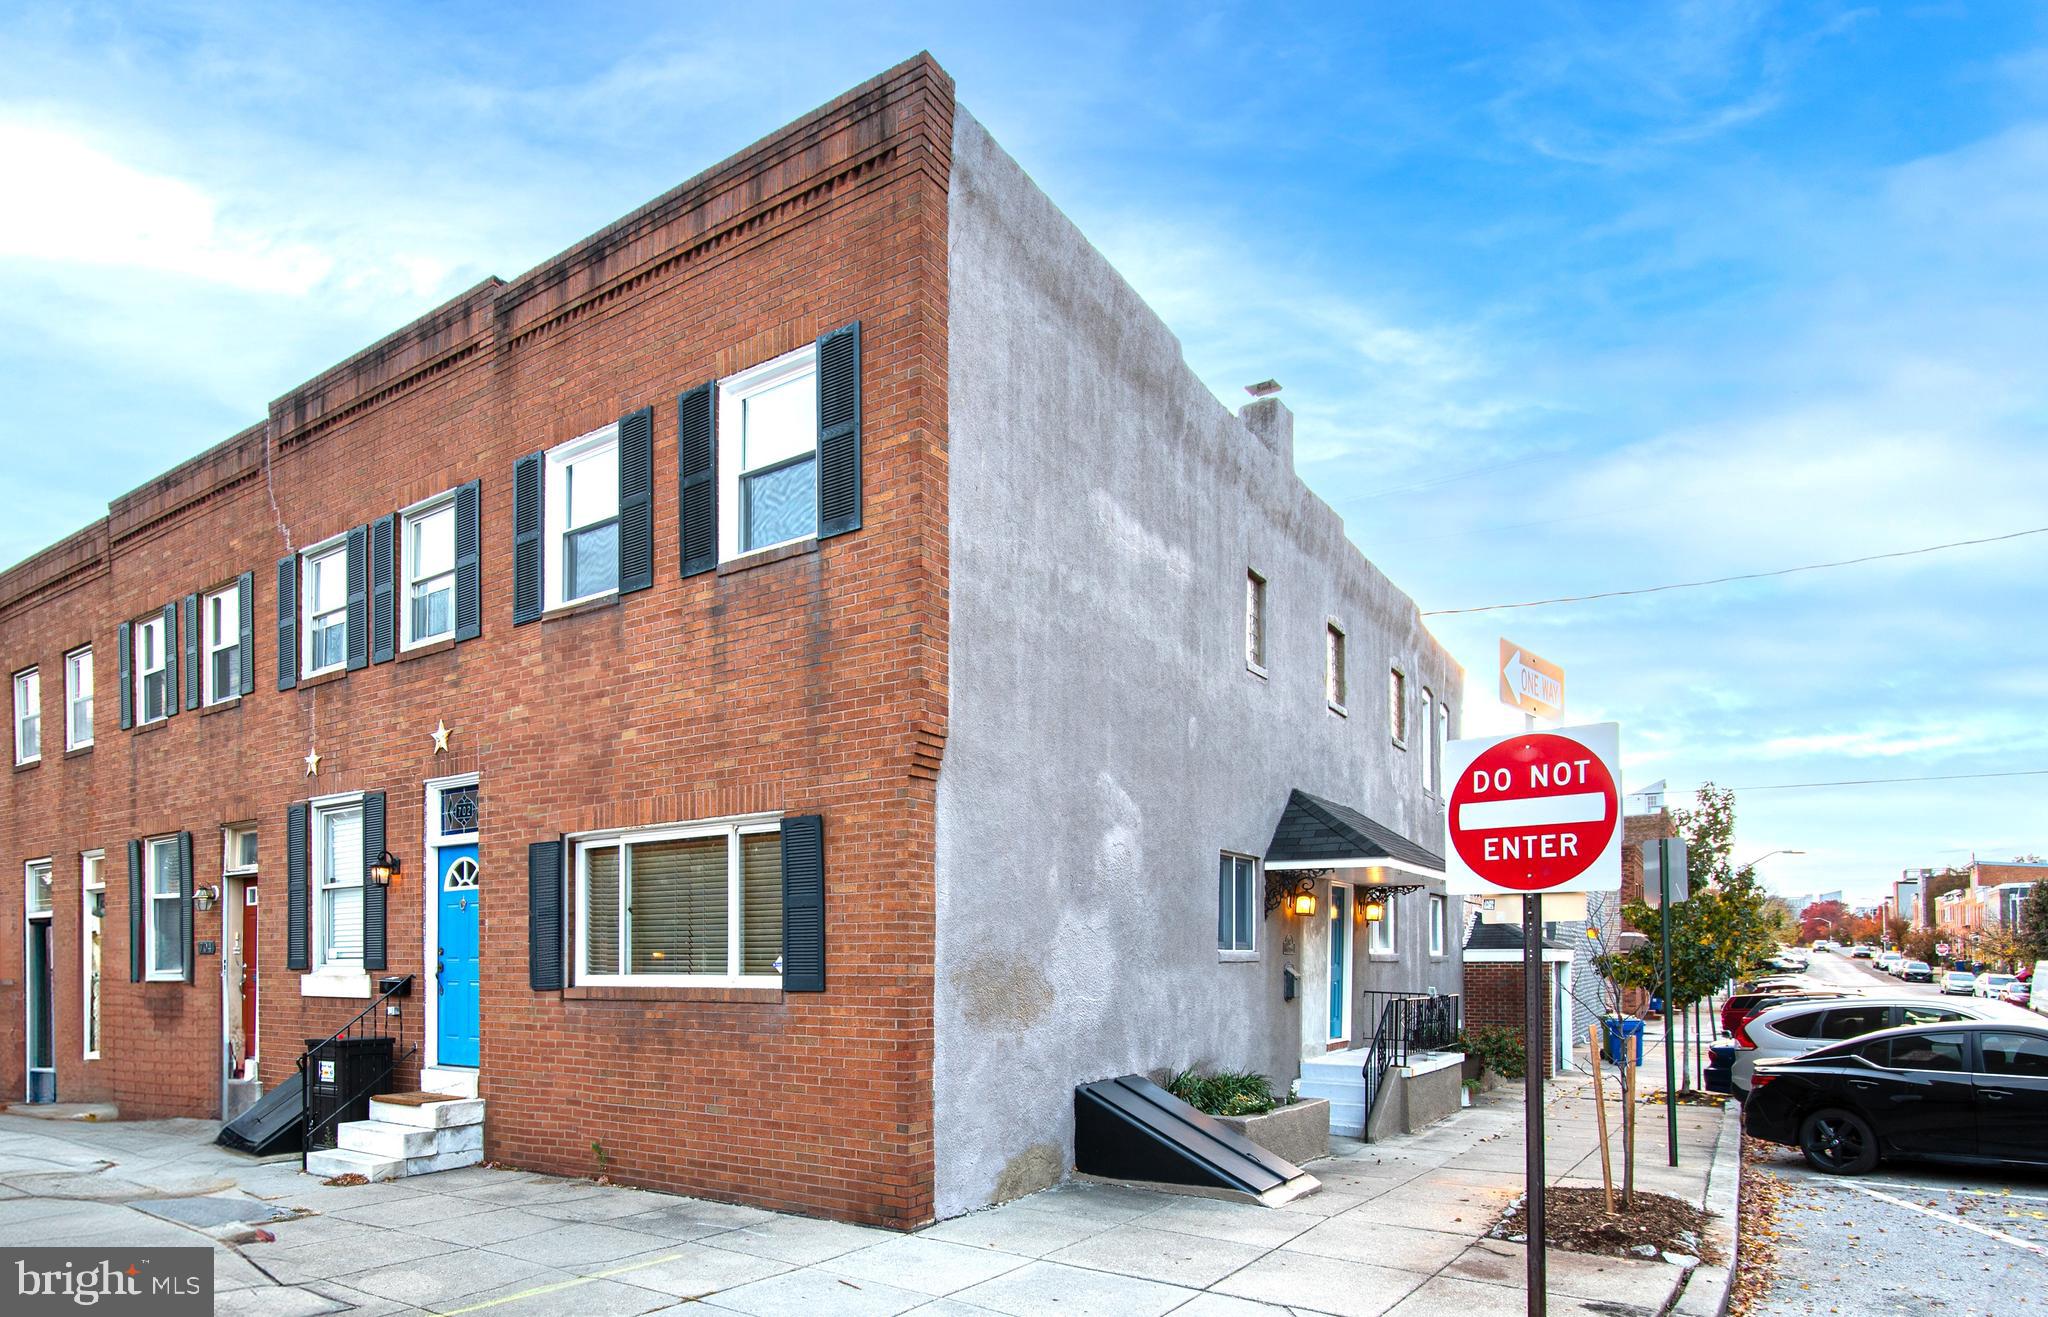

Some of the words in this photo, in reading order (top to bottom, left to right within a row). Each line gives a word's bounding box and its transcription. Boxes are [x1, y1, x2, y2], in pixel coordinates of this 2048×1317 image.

[1521, 668, 1539, 696] ONE
[1542, 677, 1559, 704] WAY
[1473, 767, 1512, 794] DO
[1530, 759, 1591, 789] NOT
[457, 806, 471, 817] 702
[1484, 833, 1578, 861] ENTER
